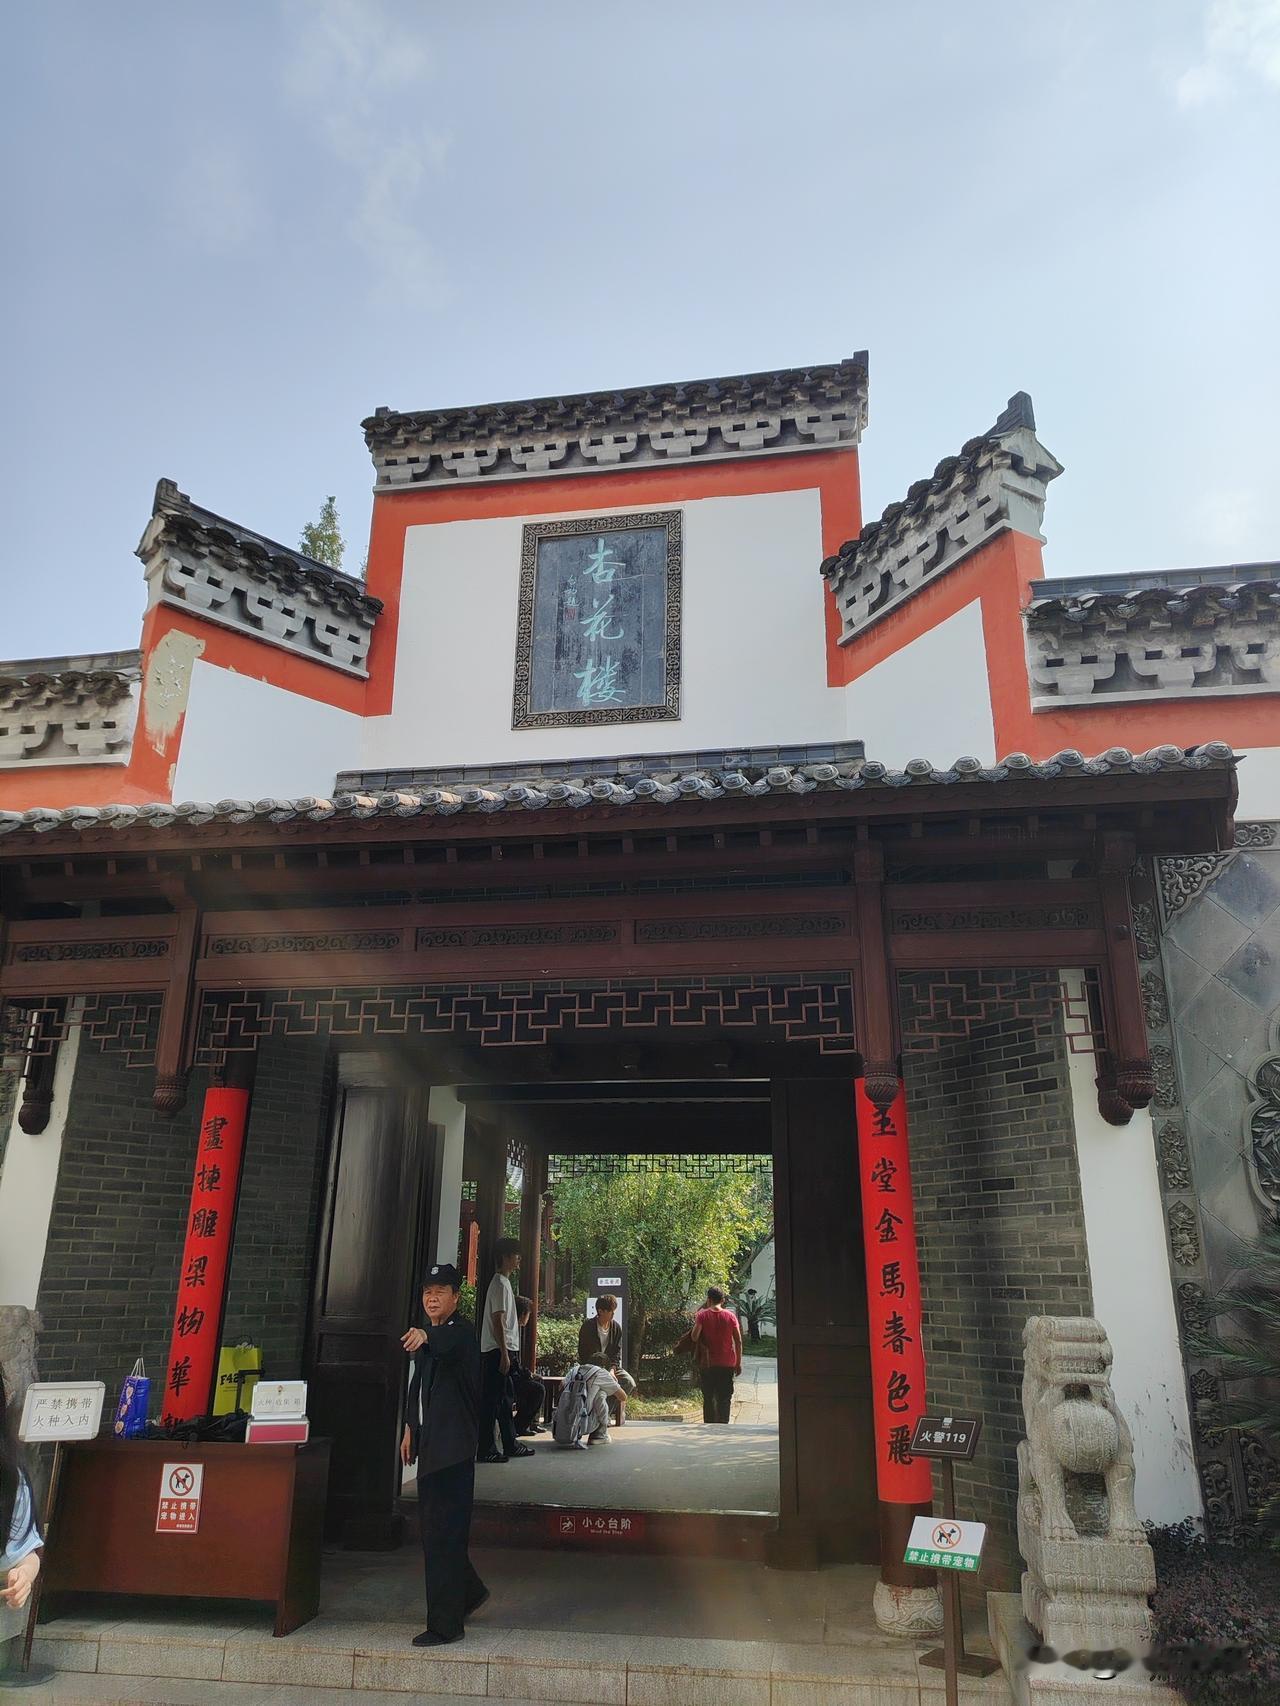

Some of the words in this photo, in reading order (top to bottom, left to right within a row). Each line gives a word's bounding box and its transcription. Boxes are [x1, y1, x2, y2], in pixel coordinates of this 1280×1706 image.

[35, 1398, 93, 1410] 严禁携带
[33, 1415, 90, 1427] 火种入内
[920, 1431, 966, 1443] 火警119
[582, 1517, 631, 1530] 小心台阶
[909, 1550, 975, 1569] 禁止携带宠物
